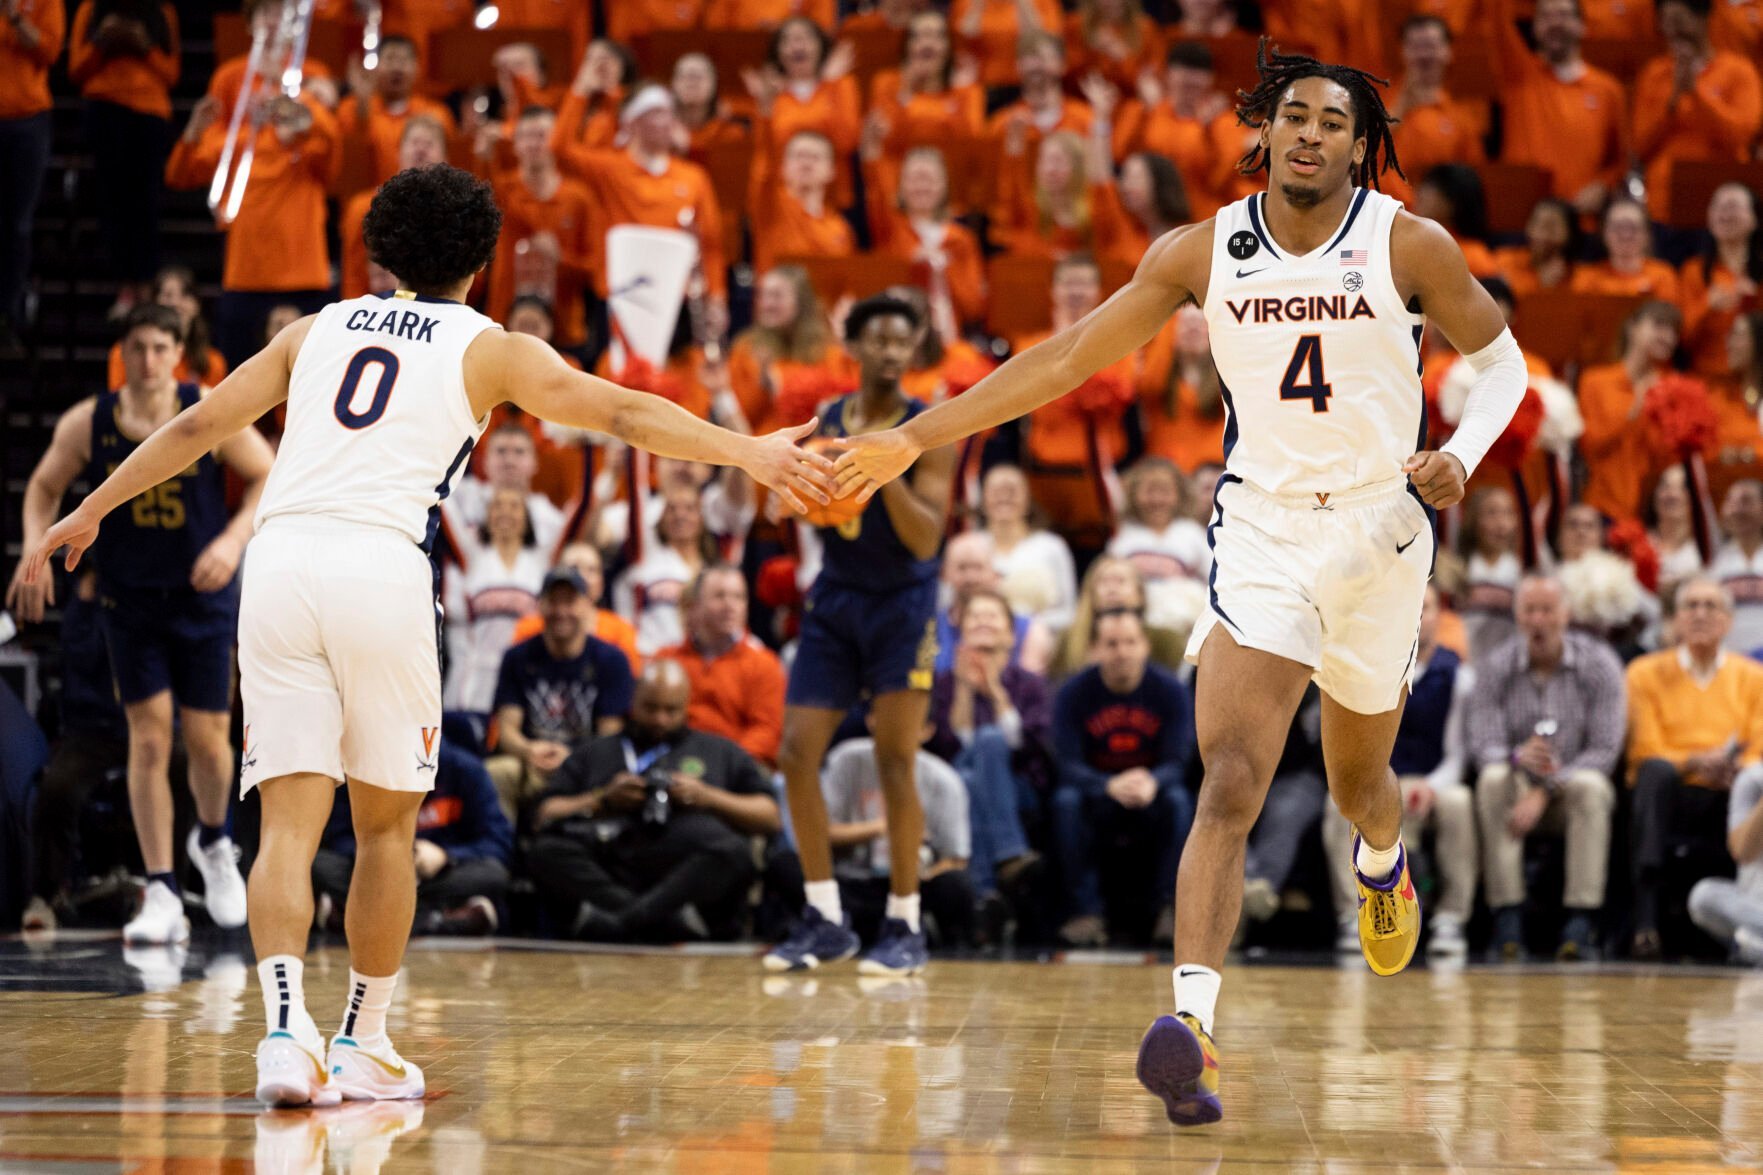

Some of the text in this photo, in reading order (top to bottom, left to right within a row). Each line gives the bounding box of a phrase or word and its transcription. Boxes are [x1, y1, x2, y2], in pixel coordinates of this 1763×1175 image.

[1233, 238, 1254, 246] 15 41
[346, 309, 441, 343] CLARK
[1225, 294, 1377, 325] VIRGINIA
[333, 345, 401, 430] 0
[1279, 333, 1333, 413] 4
[132, 480, 186, 529] 25
